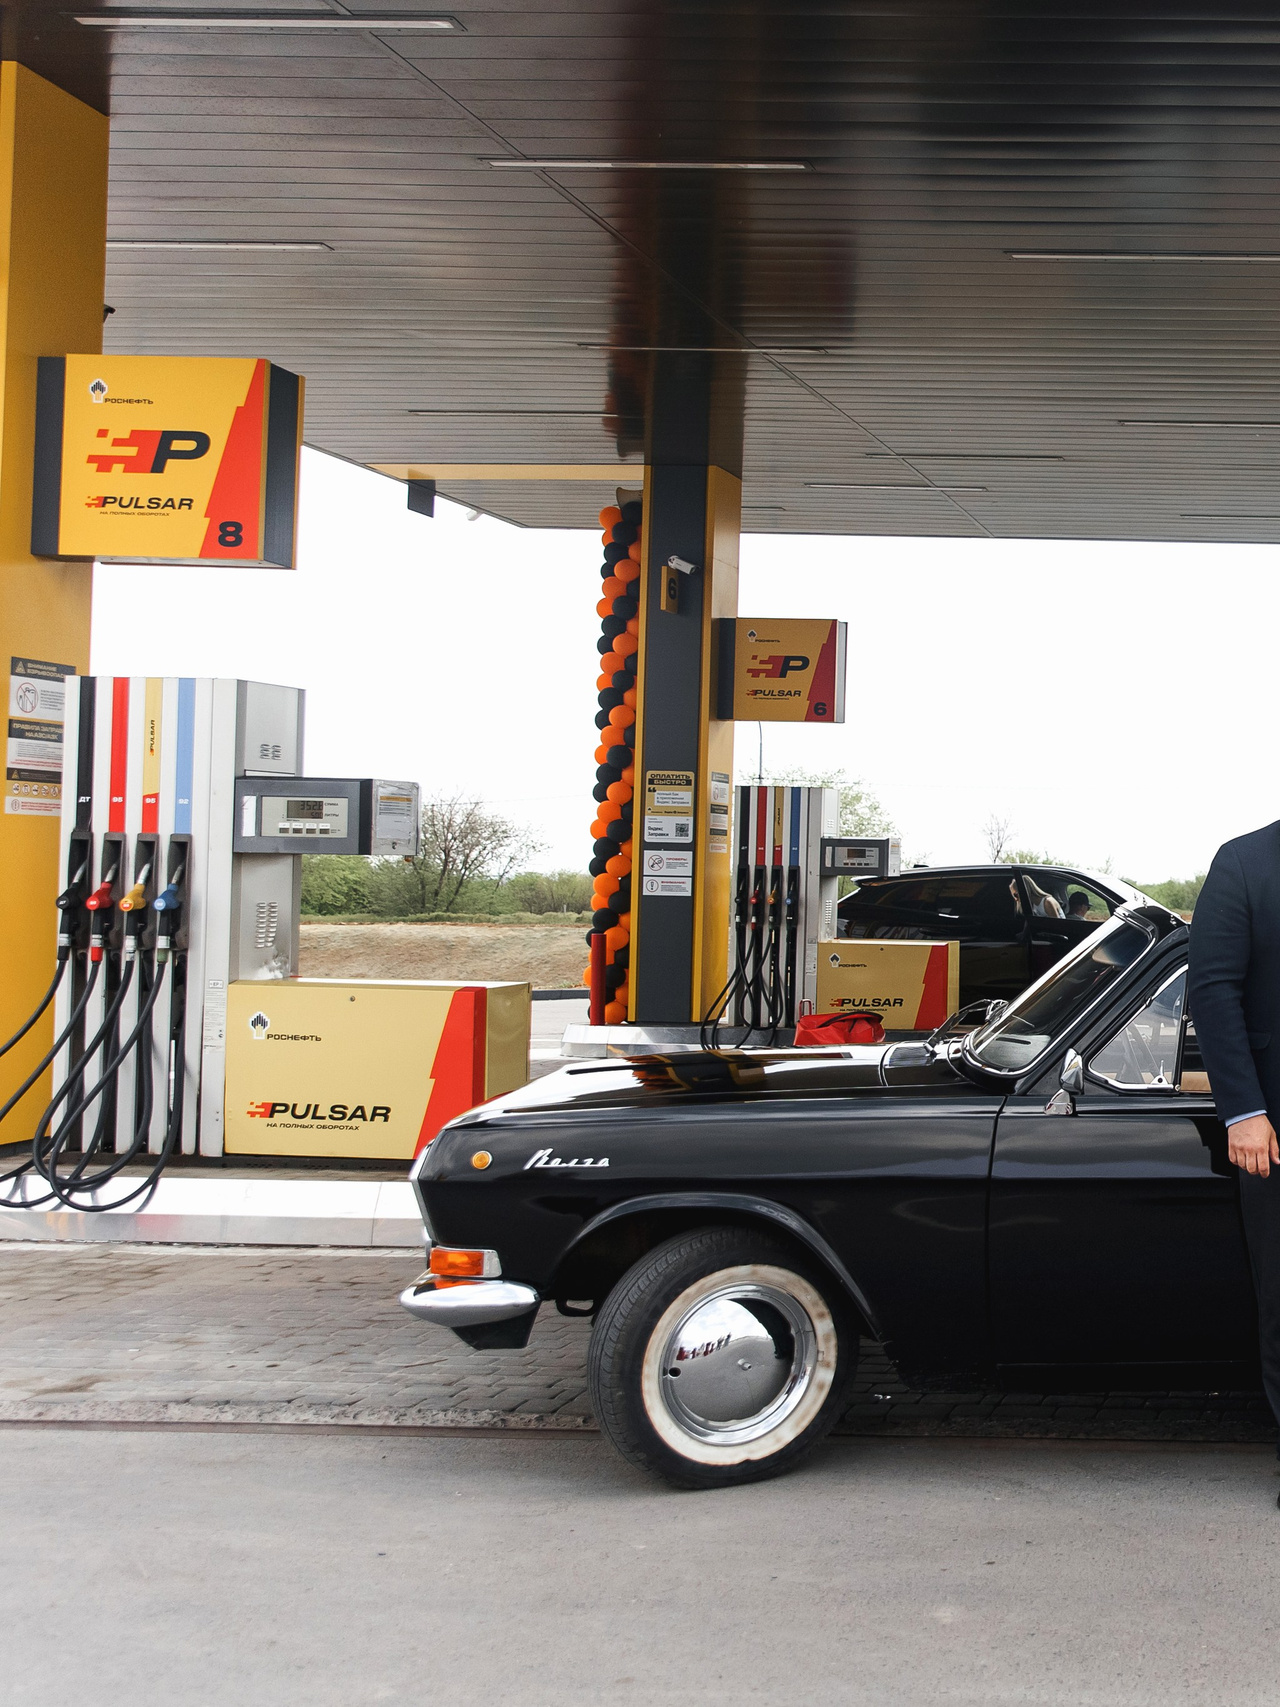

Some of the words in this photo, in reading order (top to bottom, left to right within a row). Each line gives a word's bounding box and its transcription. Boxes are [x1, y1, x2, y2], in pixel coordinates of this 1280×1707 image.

[102, 496, 194, 510] PULSAR
[218, 521, 243, 547] 8
[668, 577, 676, 600] 6
[814, 702, 827, 716] 6
[841, 998, 904, 1007] PULSAR
[267, 1033, 322, 1042] РОСНЕФТЬ
[269, 1102, 392, 1122] PULSAR
